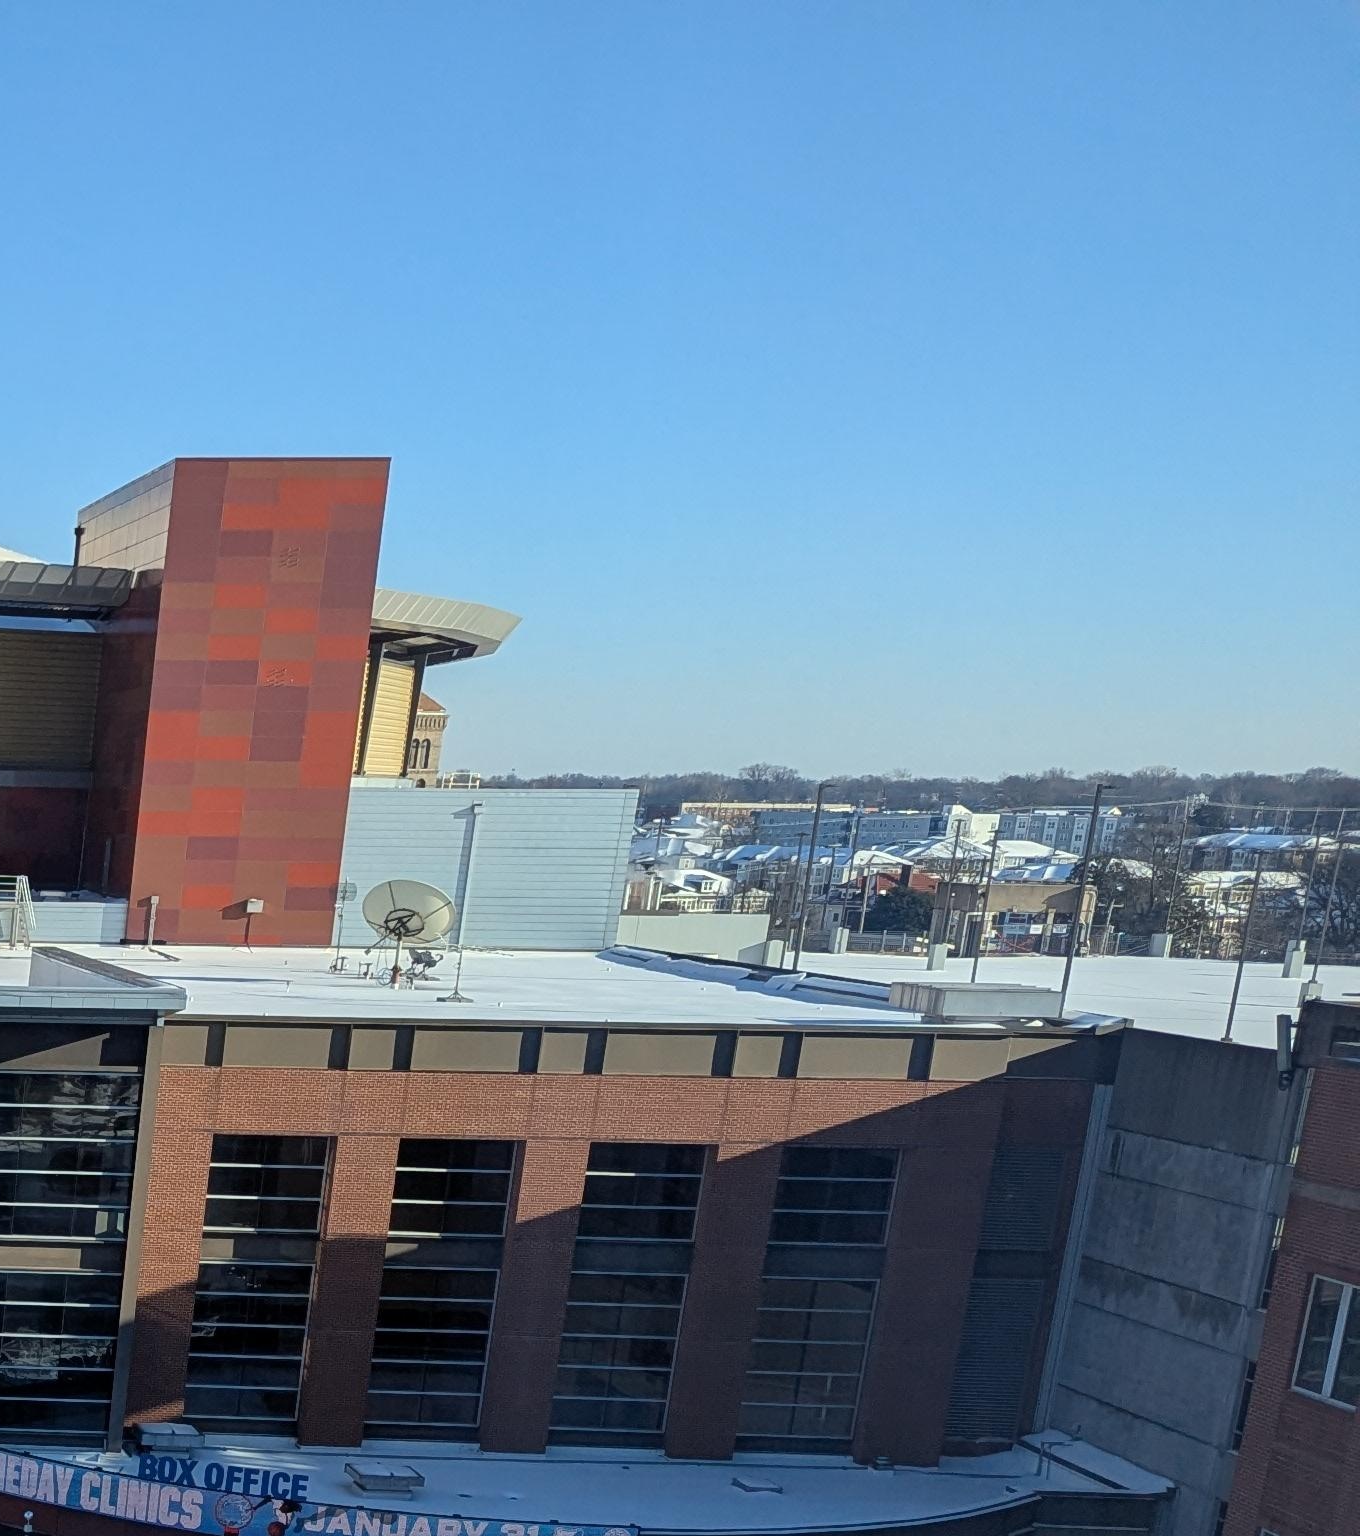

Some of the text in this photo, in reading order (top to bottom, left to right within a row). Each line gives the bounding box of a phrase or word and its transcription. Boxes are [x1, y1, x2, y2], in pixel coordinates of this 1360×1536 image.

[80, 1472, 204, 1530] CLINICS
[138, 1454, 310, 1502] BOX OFFICE
